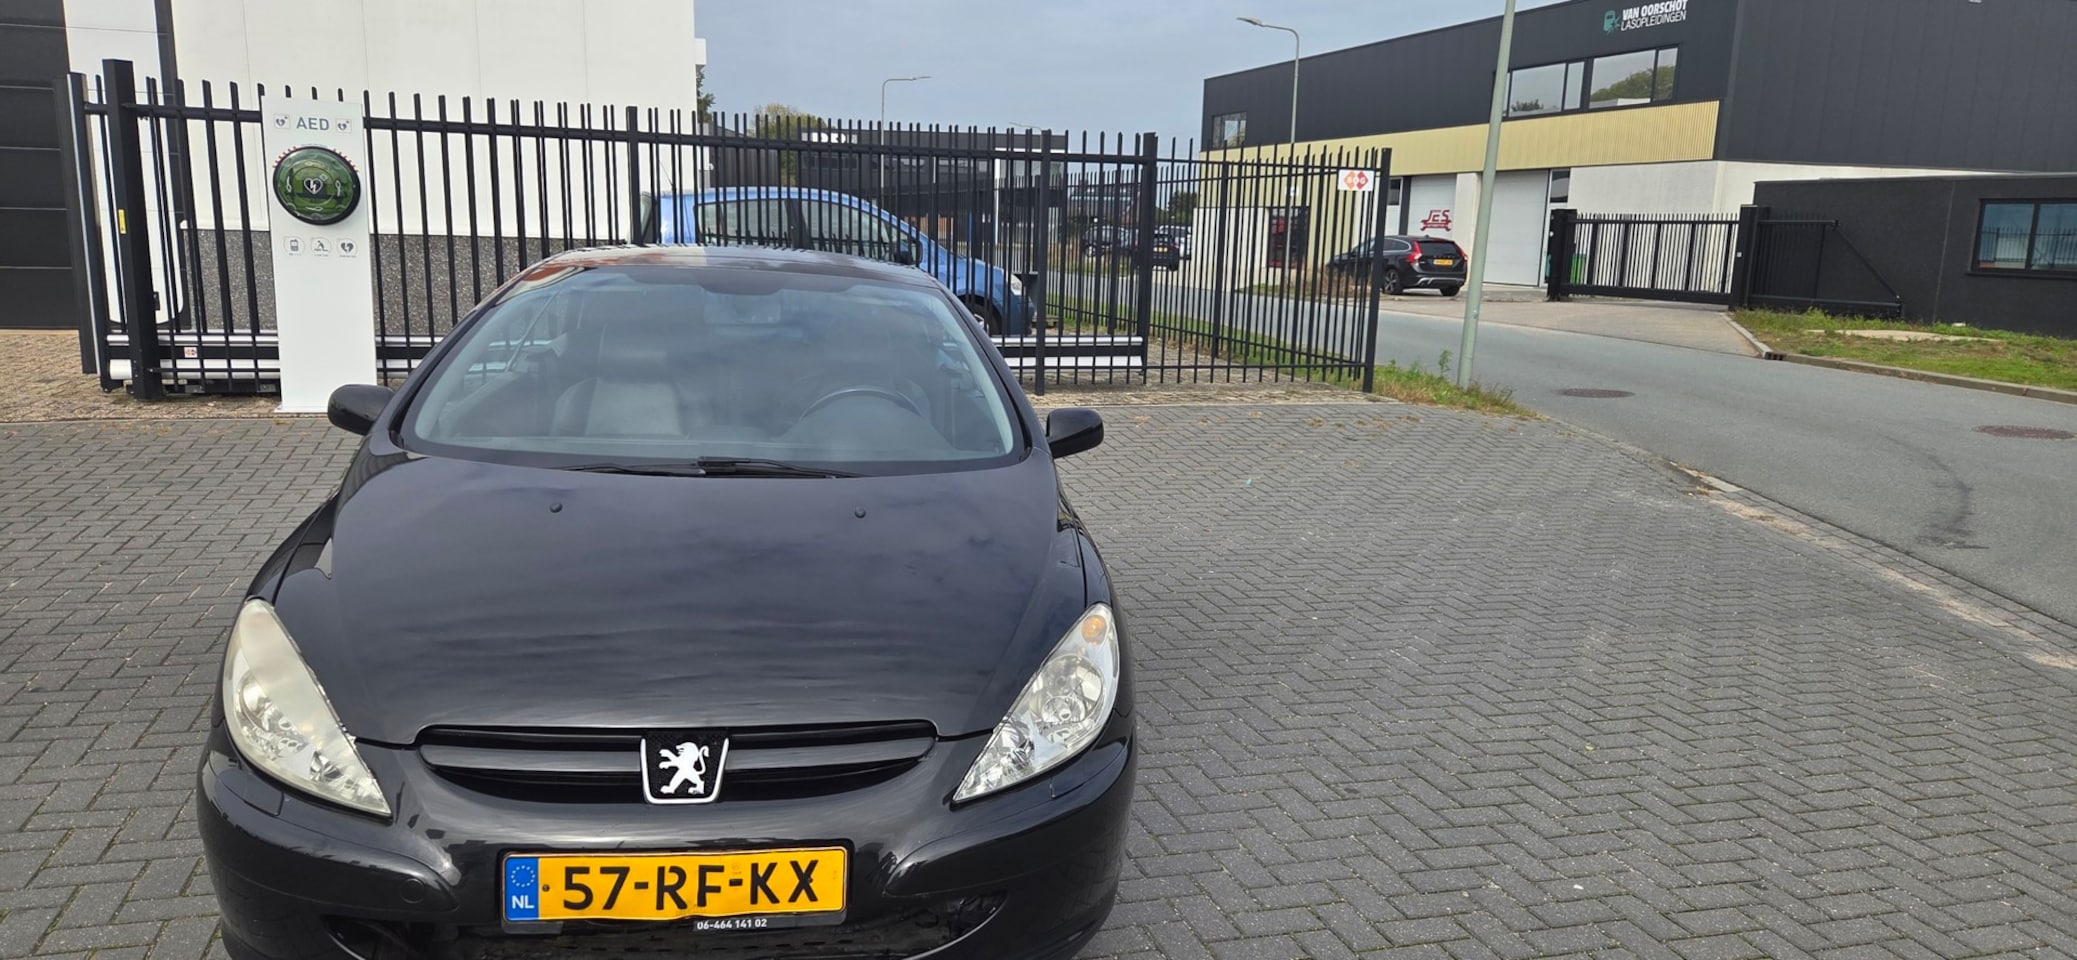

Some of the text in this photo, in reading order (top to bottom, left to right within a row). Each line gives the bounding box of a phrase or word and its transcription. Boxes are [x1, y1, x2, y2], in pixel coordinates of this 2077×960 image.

[1622, 0, 1688, 20] VAN OORSCHOT
[1621, 10, 1687, 31] LASOPLEIDINGEN
[296, 117, 329, 130] AED
[1427, 209, 1450, 222] JES
[563, 859, 819, 911] 57-RF-KX
[511, 895, 535, 909] NL
[697, 918, 768, 930] 06-464 141 02
